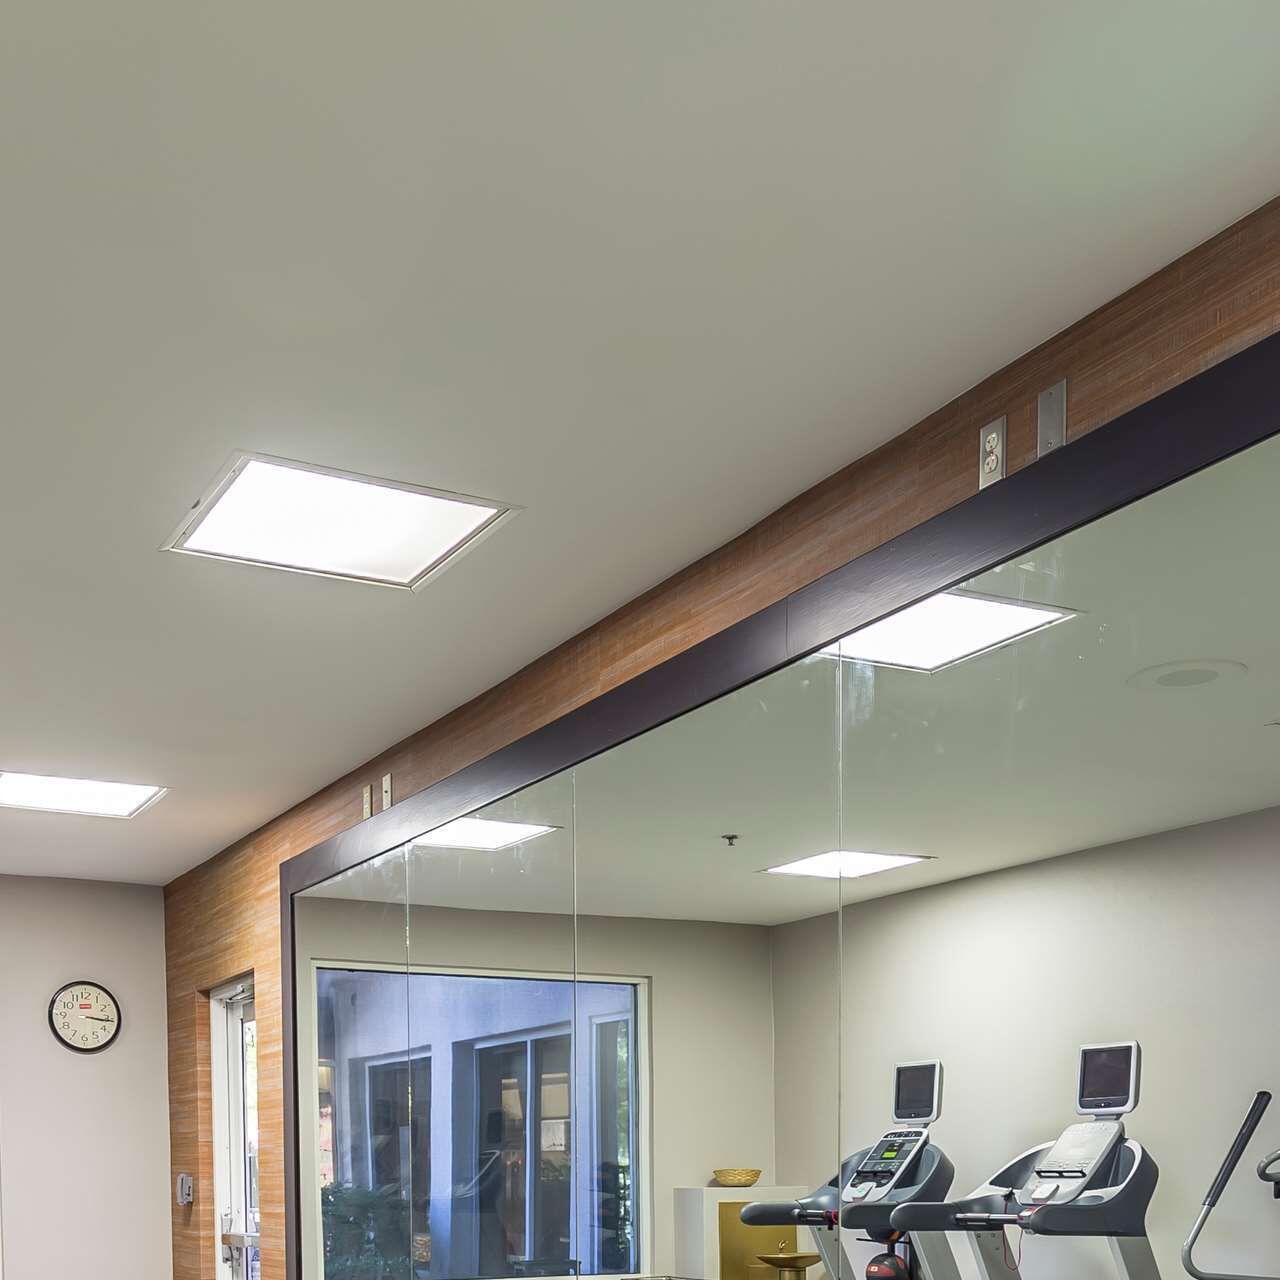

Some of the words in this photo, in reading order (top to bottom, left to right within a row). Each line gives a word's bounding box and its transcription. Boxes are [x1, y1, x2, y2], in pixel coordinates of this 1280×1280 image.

[71, 994, 79, 1002] 11
[80, 991, 92, 1000] 12
[63, 1001, 74, 1010] 10
[100, 1004, 107, 1012] 2
[60, 1011, 67, 1019] 9
[62, 1021, 70, 1030] 8
[100, 1025, 107, 1033] 4
[71, 1029, 78, 1037] 7
[92, 1031, 99, 1040] 5
[81, 1033, 88, 1042] 6
